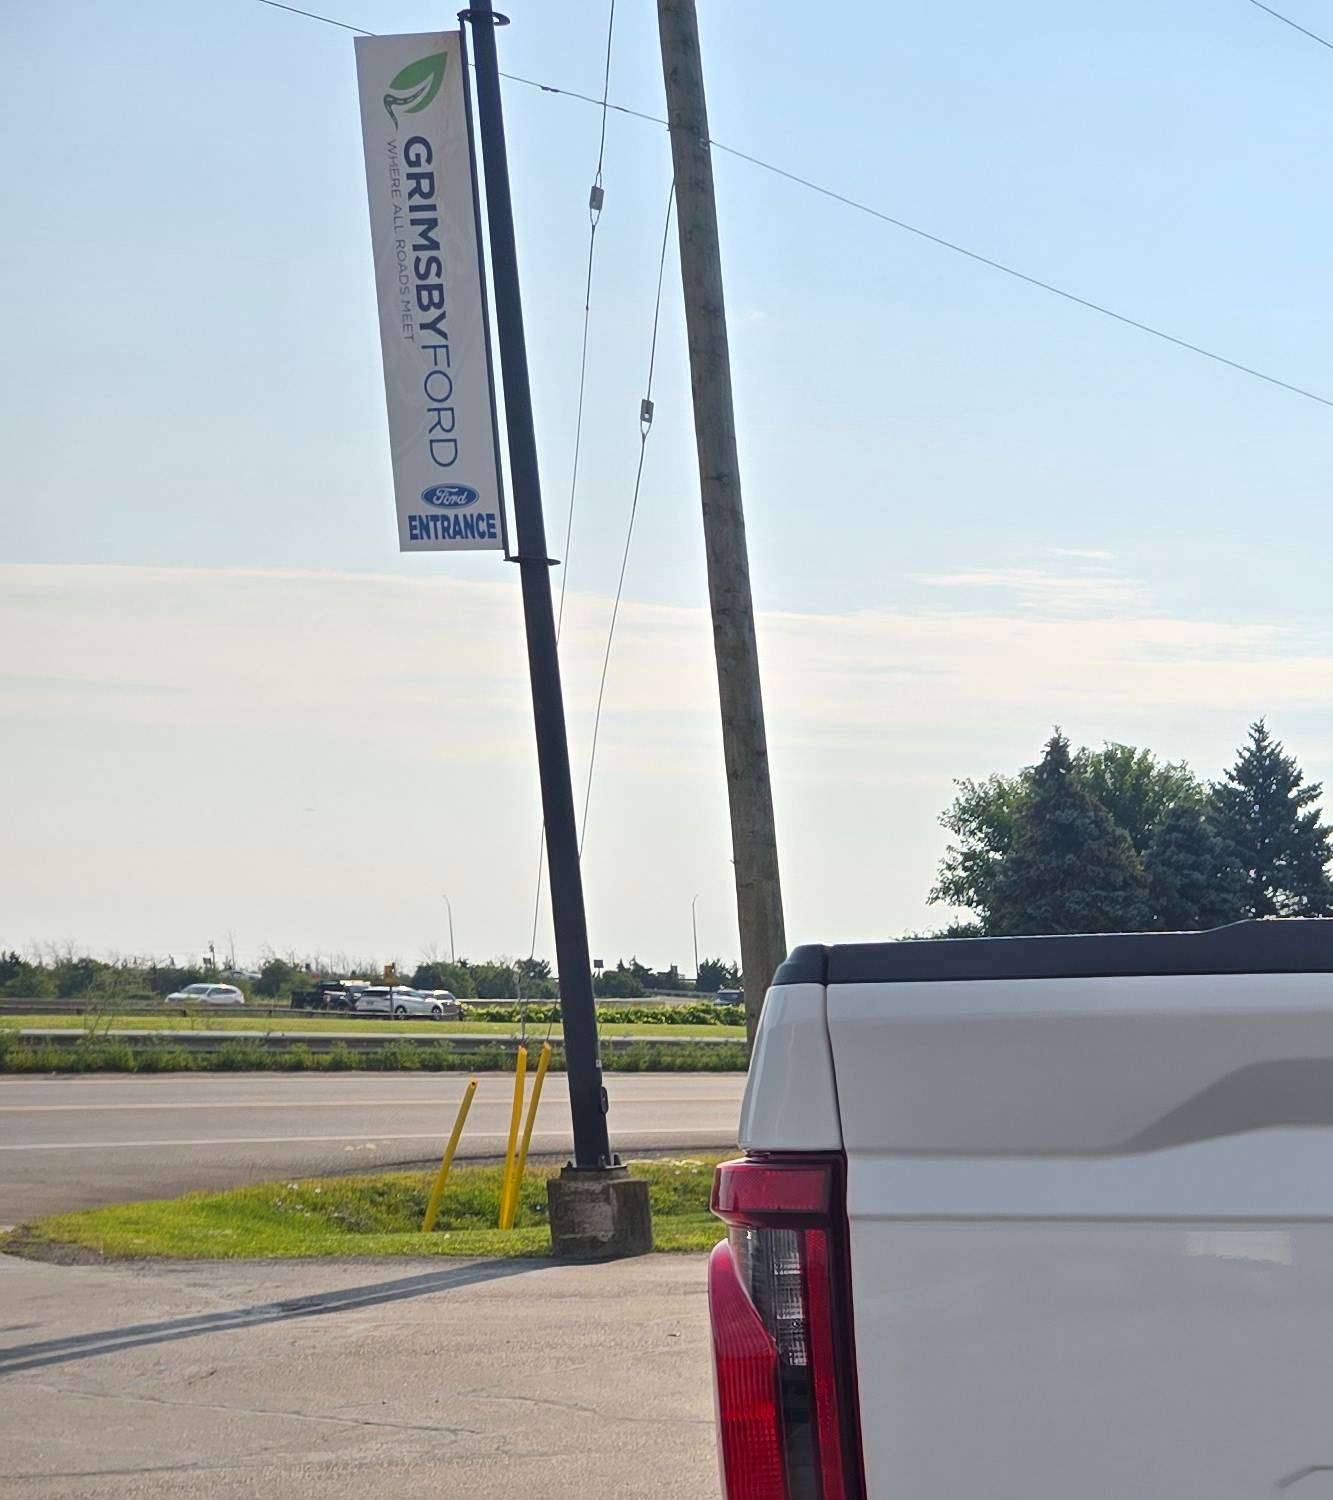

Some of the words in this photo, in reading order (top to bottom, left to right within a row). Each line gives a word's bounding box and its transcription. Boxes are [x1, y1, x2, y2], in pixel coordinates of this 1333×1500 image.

[386, 140, 402, 198] WHERE
[393, 204, 404, 232] ALL
[395, 239, 410, 296] ROADS
[401, 300, 415, 342] MEET
[403, 135, 459, 468] GRIMSBYFORD
[432, 487, 468, 505] Ford
[407, 512, 497, 541] ENTRANCE
